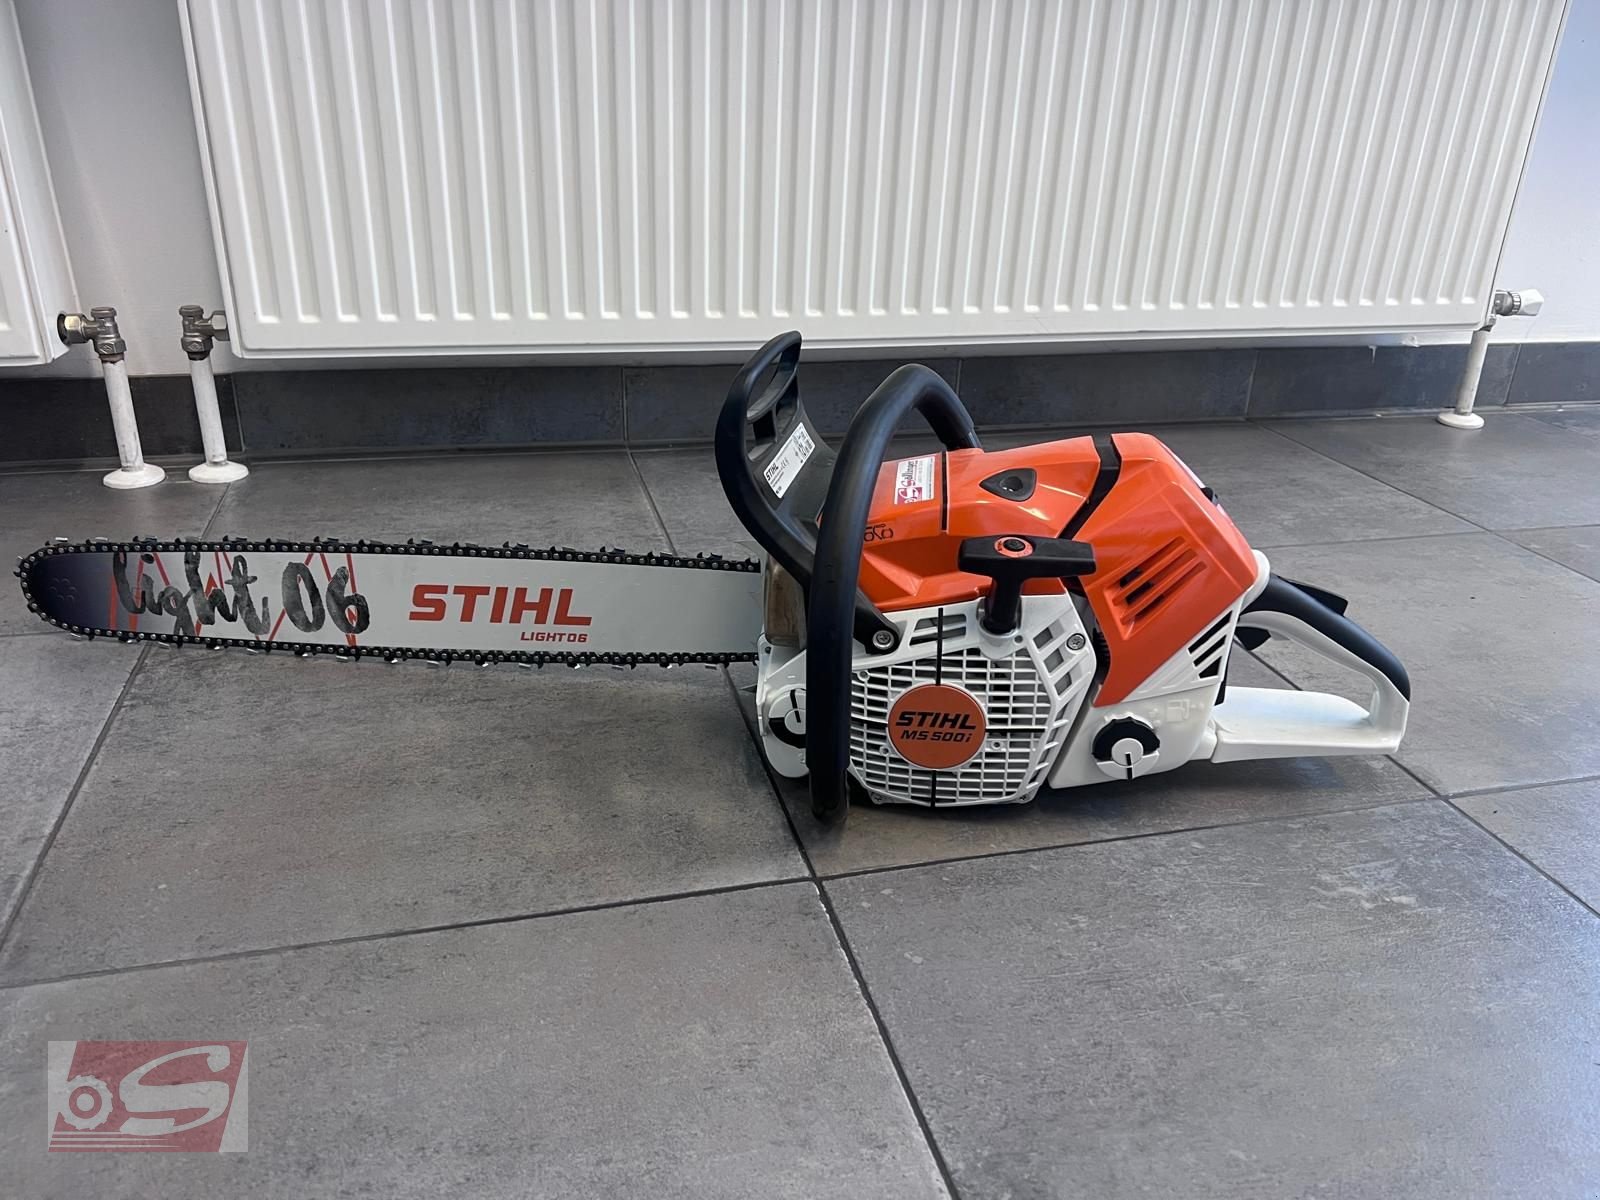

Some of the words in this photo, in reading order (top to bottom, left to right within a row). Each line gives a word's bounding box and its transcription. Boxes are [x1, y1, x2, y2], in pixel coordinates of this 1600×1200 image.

[766, 463, 779, 481] STIHL
[281, 561, 370, 634] 06
[409, 584, 592, 626] STIHL
[896, 711, 976, 730] STIHL
[901, 730, 929, 741] MS
[930, 732, 972, 743] 500i
